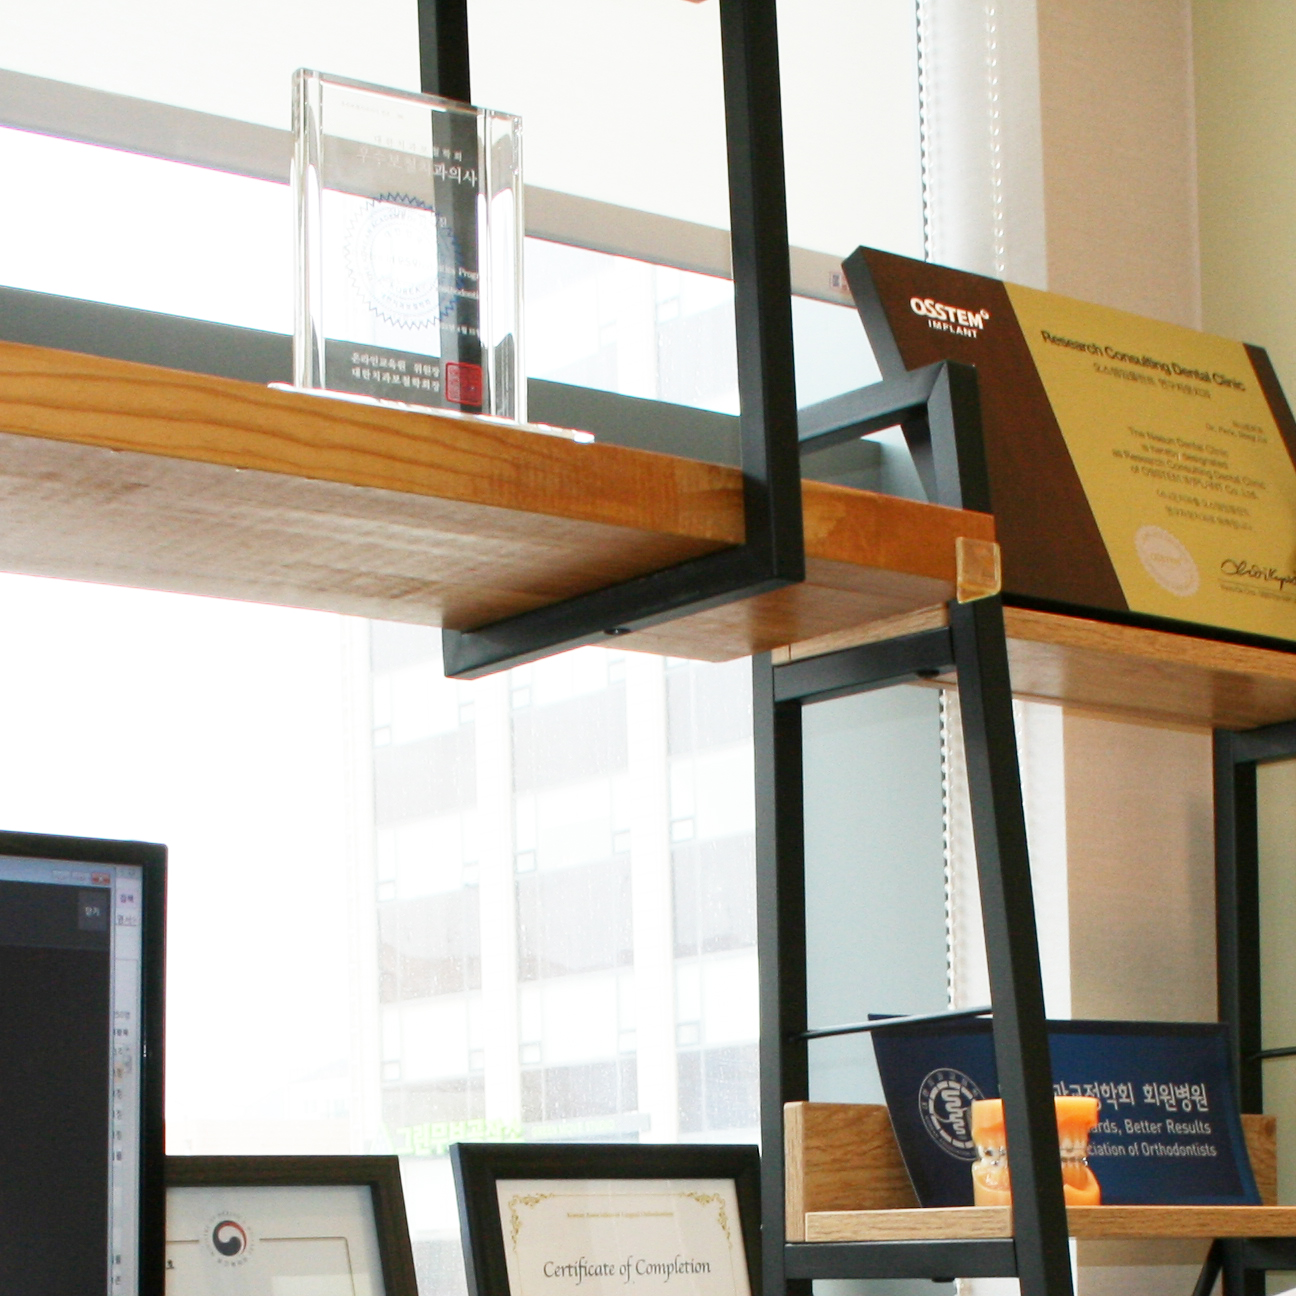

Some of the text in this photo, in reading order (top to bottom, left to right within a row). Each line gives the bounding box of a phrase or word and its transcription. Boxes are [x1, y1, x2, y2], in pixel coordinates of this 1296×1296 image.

[910, 297, 988, 331] OSSTEM
[928, 319, 978, 339] IMPLANT
[1041, 329, 1246, 392] Research Consulting Dental Clinic
[1142, 1081, 1210, 1112] 회원병원
[1124, 1118, 1163, 1135] Better
[1166, 1119, 1212, 1135] Results
[1128, 1141, 1139, 1157] of
[1141, 1141, 1217, 1158] Orthodontists
[543, 1254, 712, 1287] Certificate of Completion
